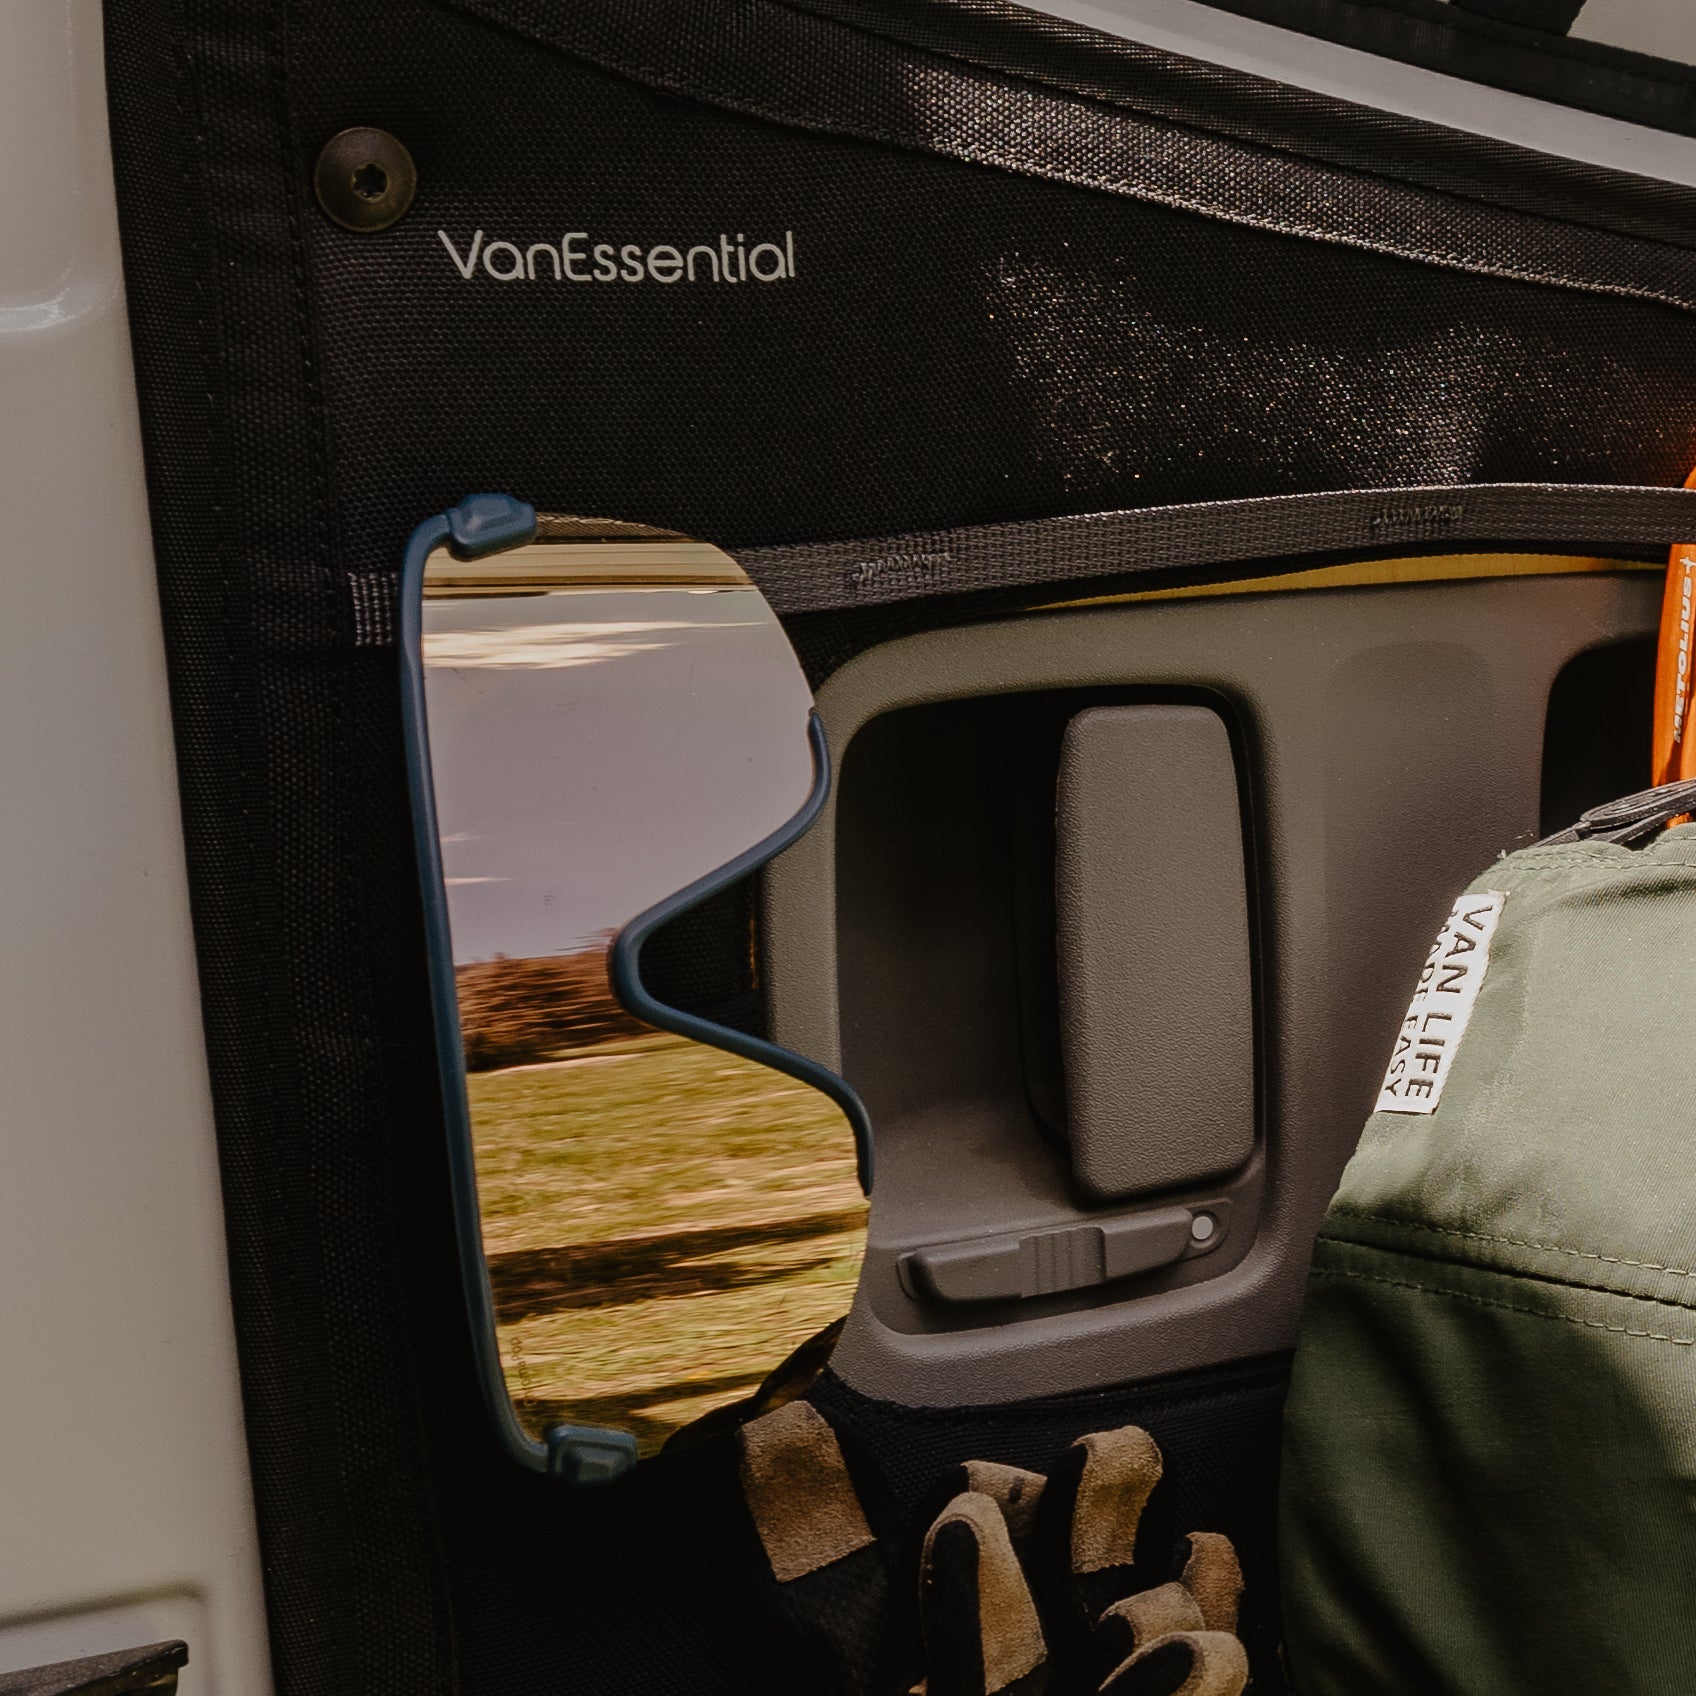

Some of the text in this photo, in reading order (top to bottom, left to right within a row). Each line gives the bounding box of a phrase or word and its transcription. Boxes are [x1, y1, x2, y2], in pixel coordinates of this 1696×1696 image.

[437, 229, 796, 284] VanEssential
[1673, 576, 1694, 744] METOLIUS
[1384, 1014, 1419, 1097] EASY
[1404, 904, 1494, 1100] VAN LIFE
